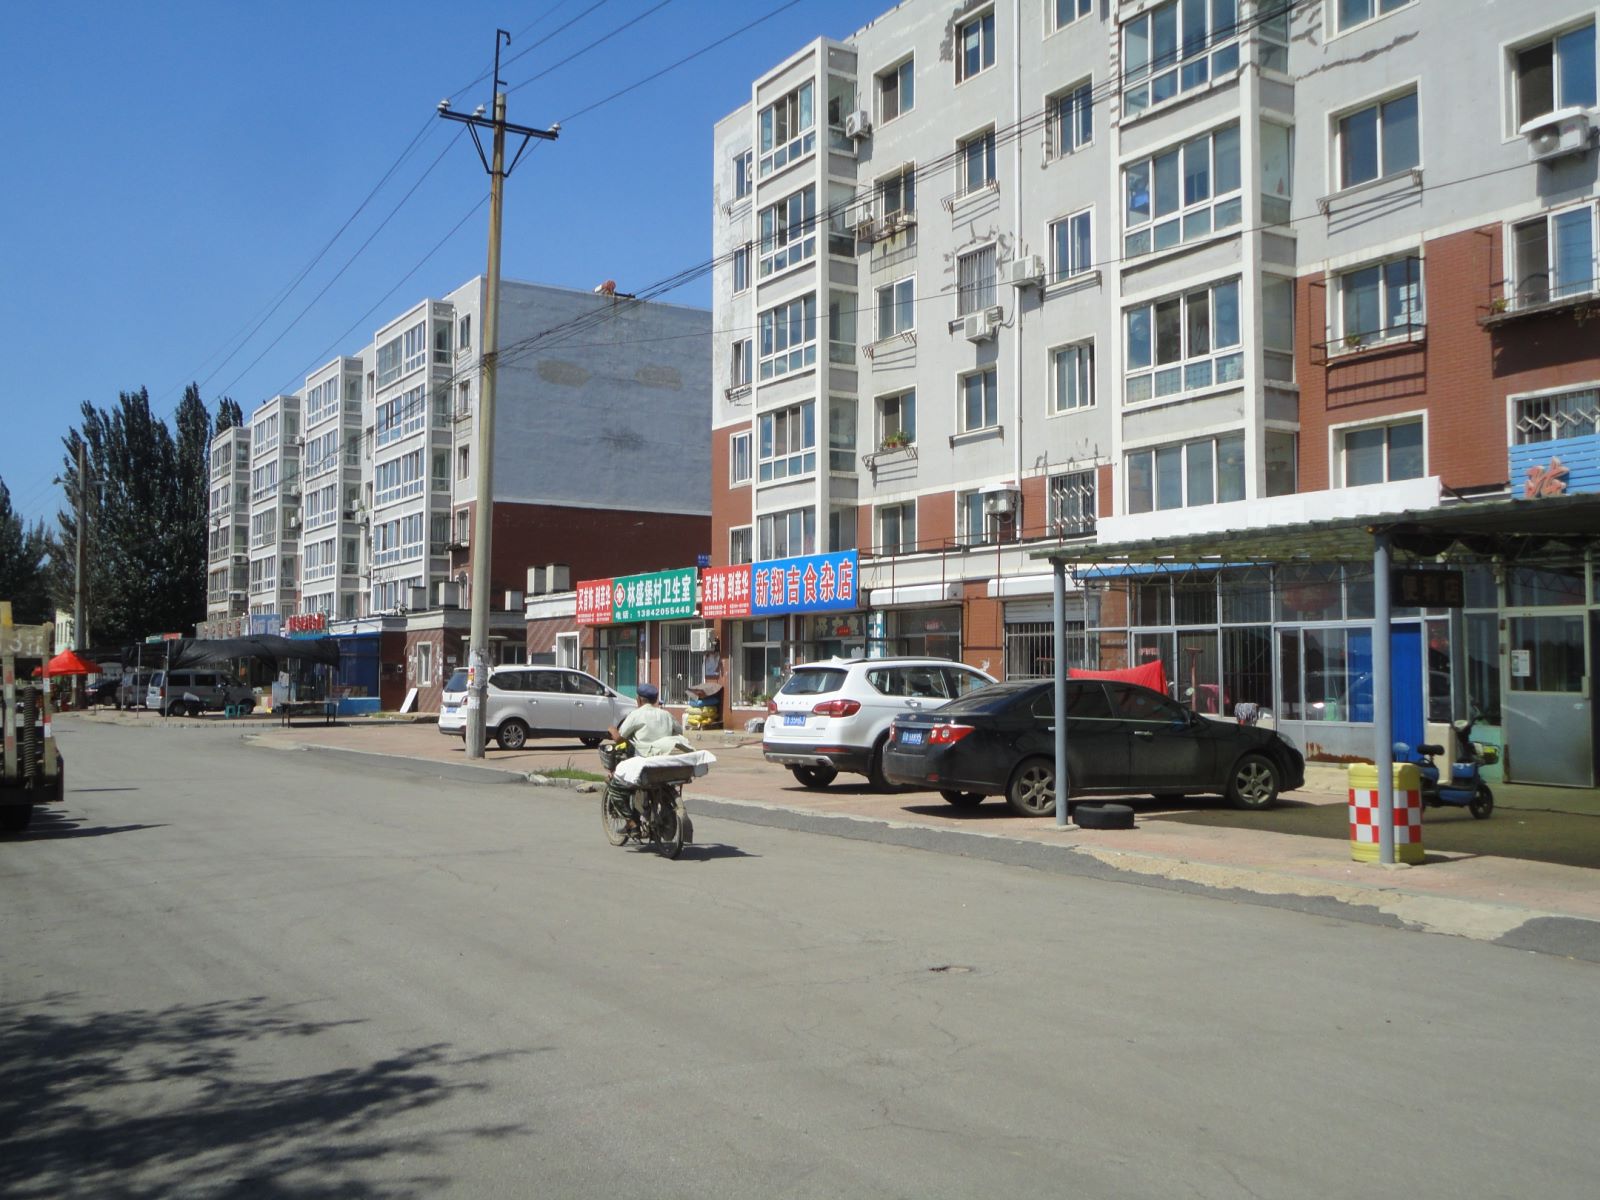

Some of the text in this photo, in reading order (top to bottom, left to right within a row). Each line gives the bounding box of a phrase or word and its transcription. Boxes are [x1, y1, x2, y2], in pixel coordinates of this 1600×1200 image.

[627, 574, 691, 608] 林盛堡村卫生室
[705, 572, 725, 602] 买首饰
[755, 558, 853, 607] 新翔吉食杂店
